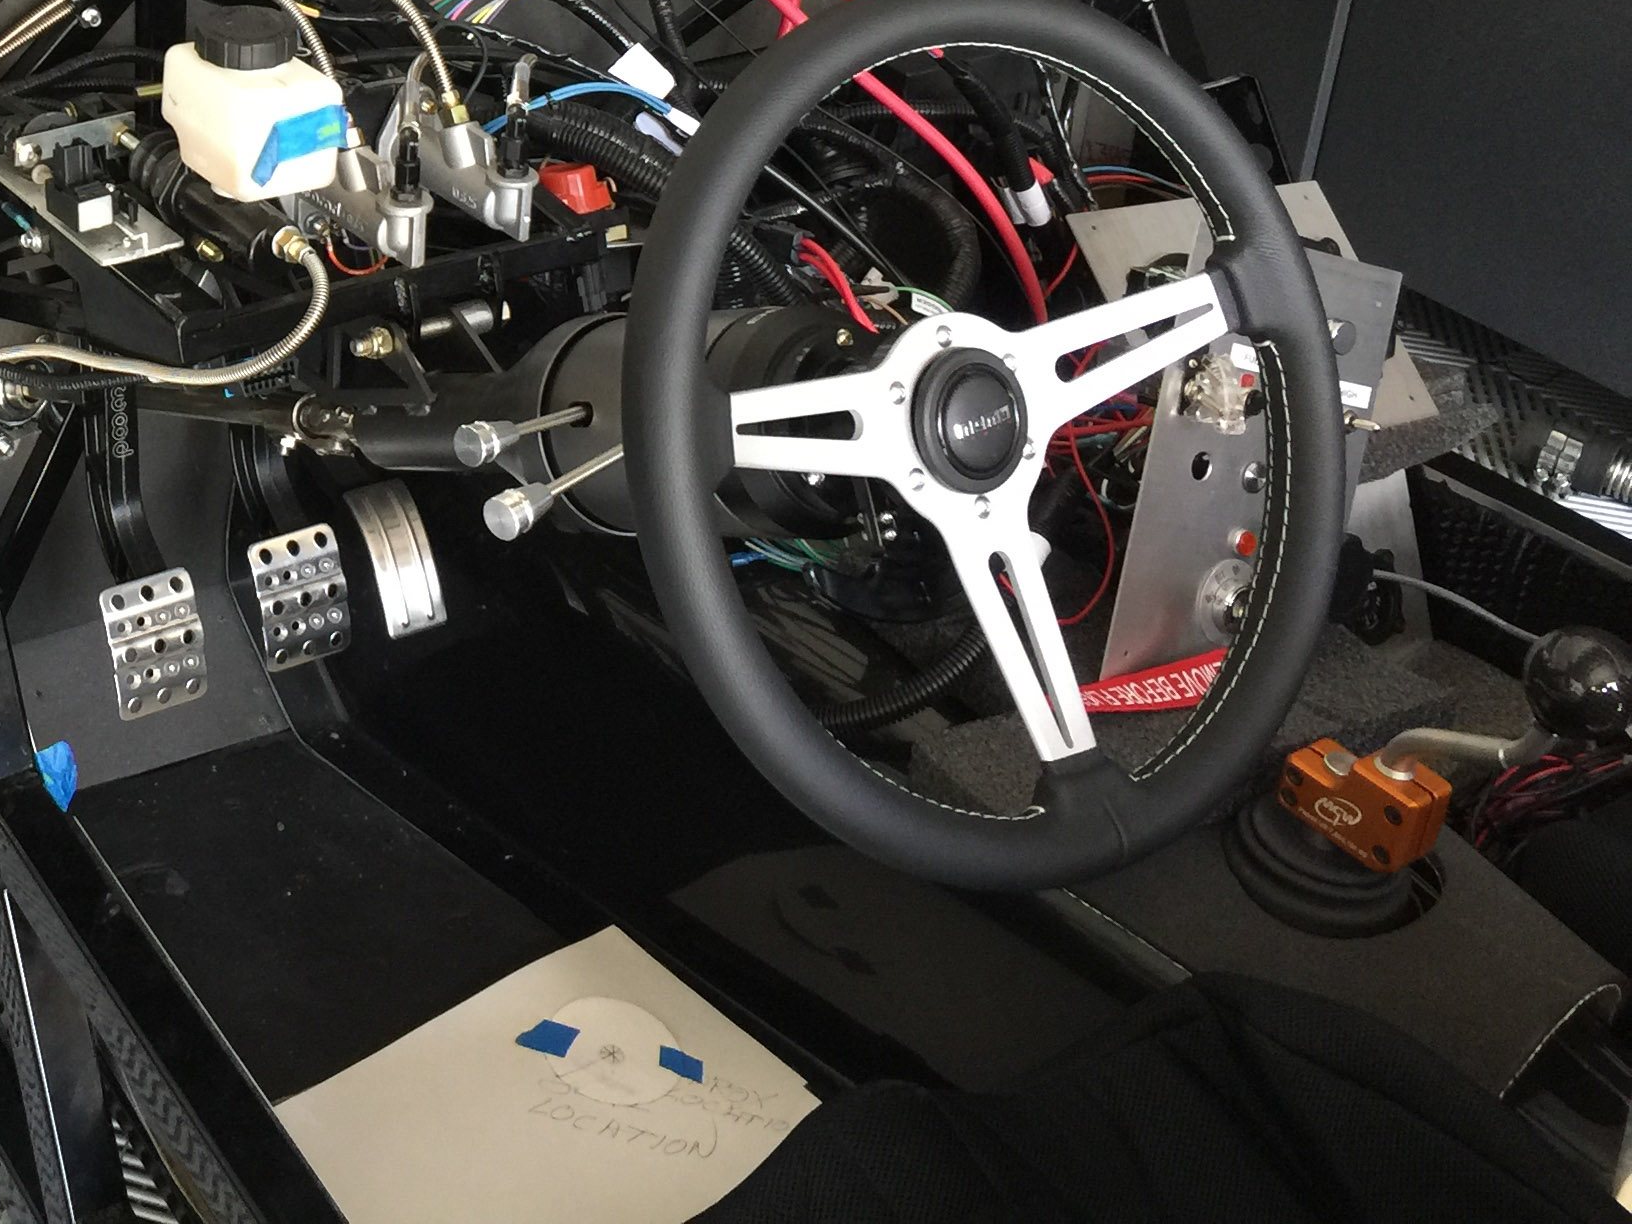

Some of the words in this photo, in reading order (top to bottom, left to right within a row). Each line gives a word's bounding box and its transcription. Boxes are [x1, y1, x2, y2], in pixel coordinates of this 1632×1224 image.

[1108, 675, 1182, 705] BEFORE
[1169, 661, 1222, 698] MOVE
[528, 1097, 718, 1159] LOCATION
